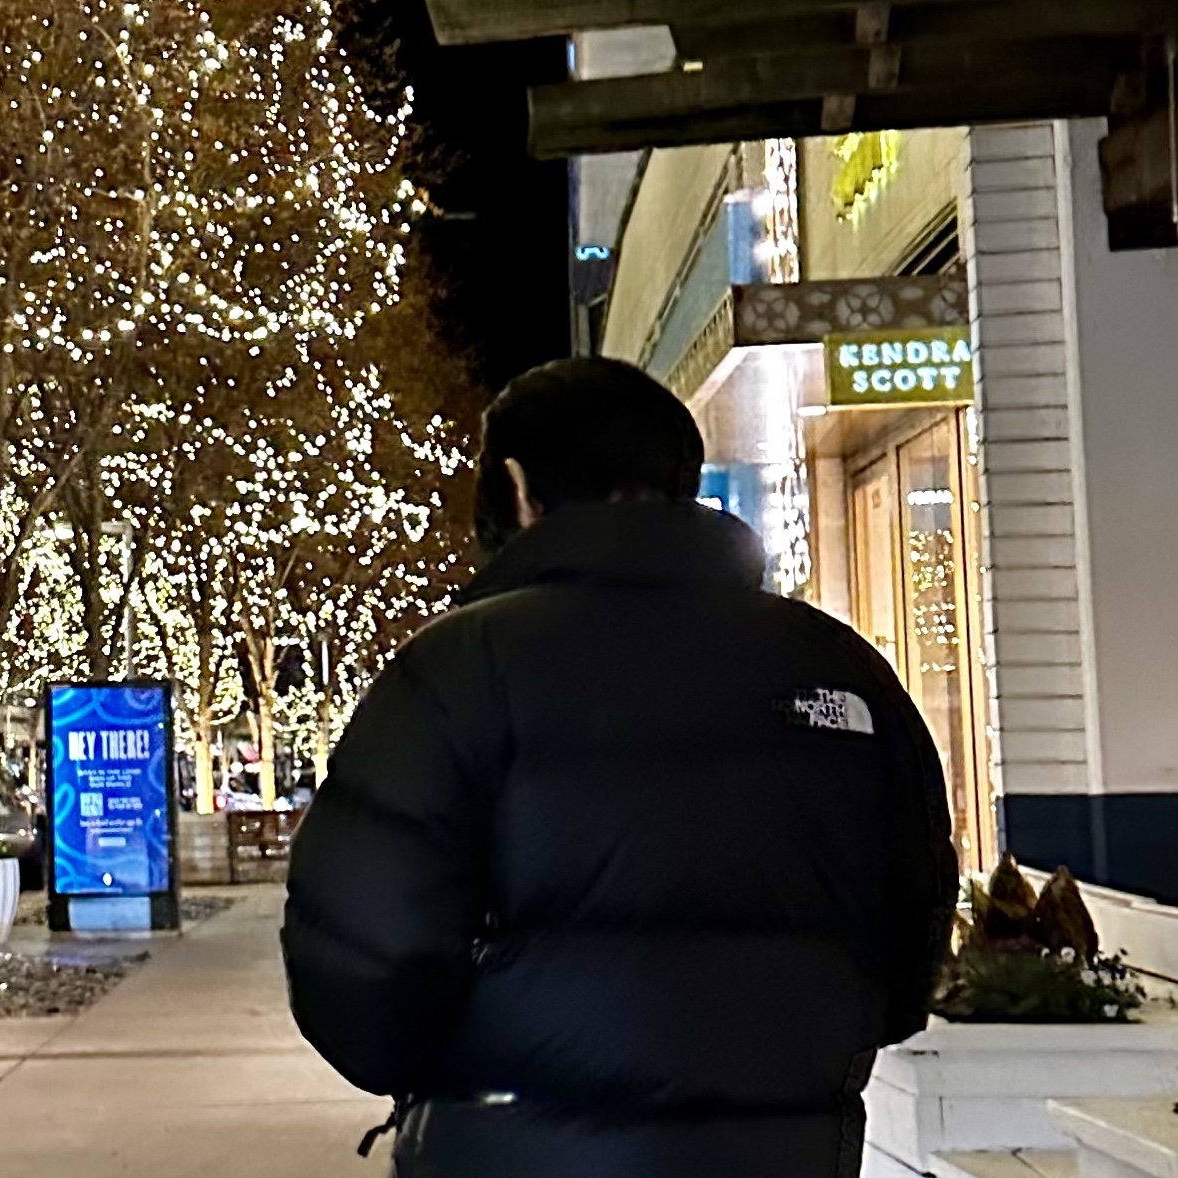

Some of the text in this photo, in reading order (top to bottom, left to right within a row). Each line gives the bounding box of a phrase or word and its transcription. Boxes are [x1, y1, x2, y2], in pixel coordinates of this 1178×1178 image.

[839, 340, 971, 368] KENDRA
[852, 365, 961, 393] SCOTT
[68, 729, 150, 760] HEY THERE!
